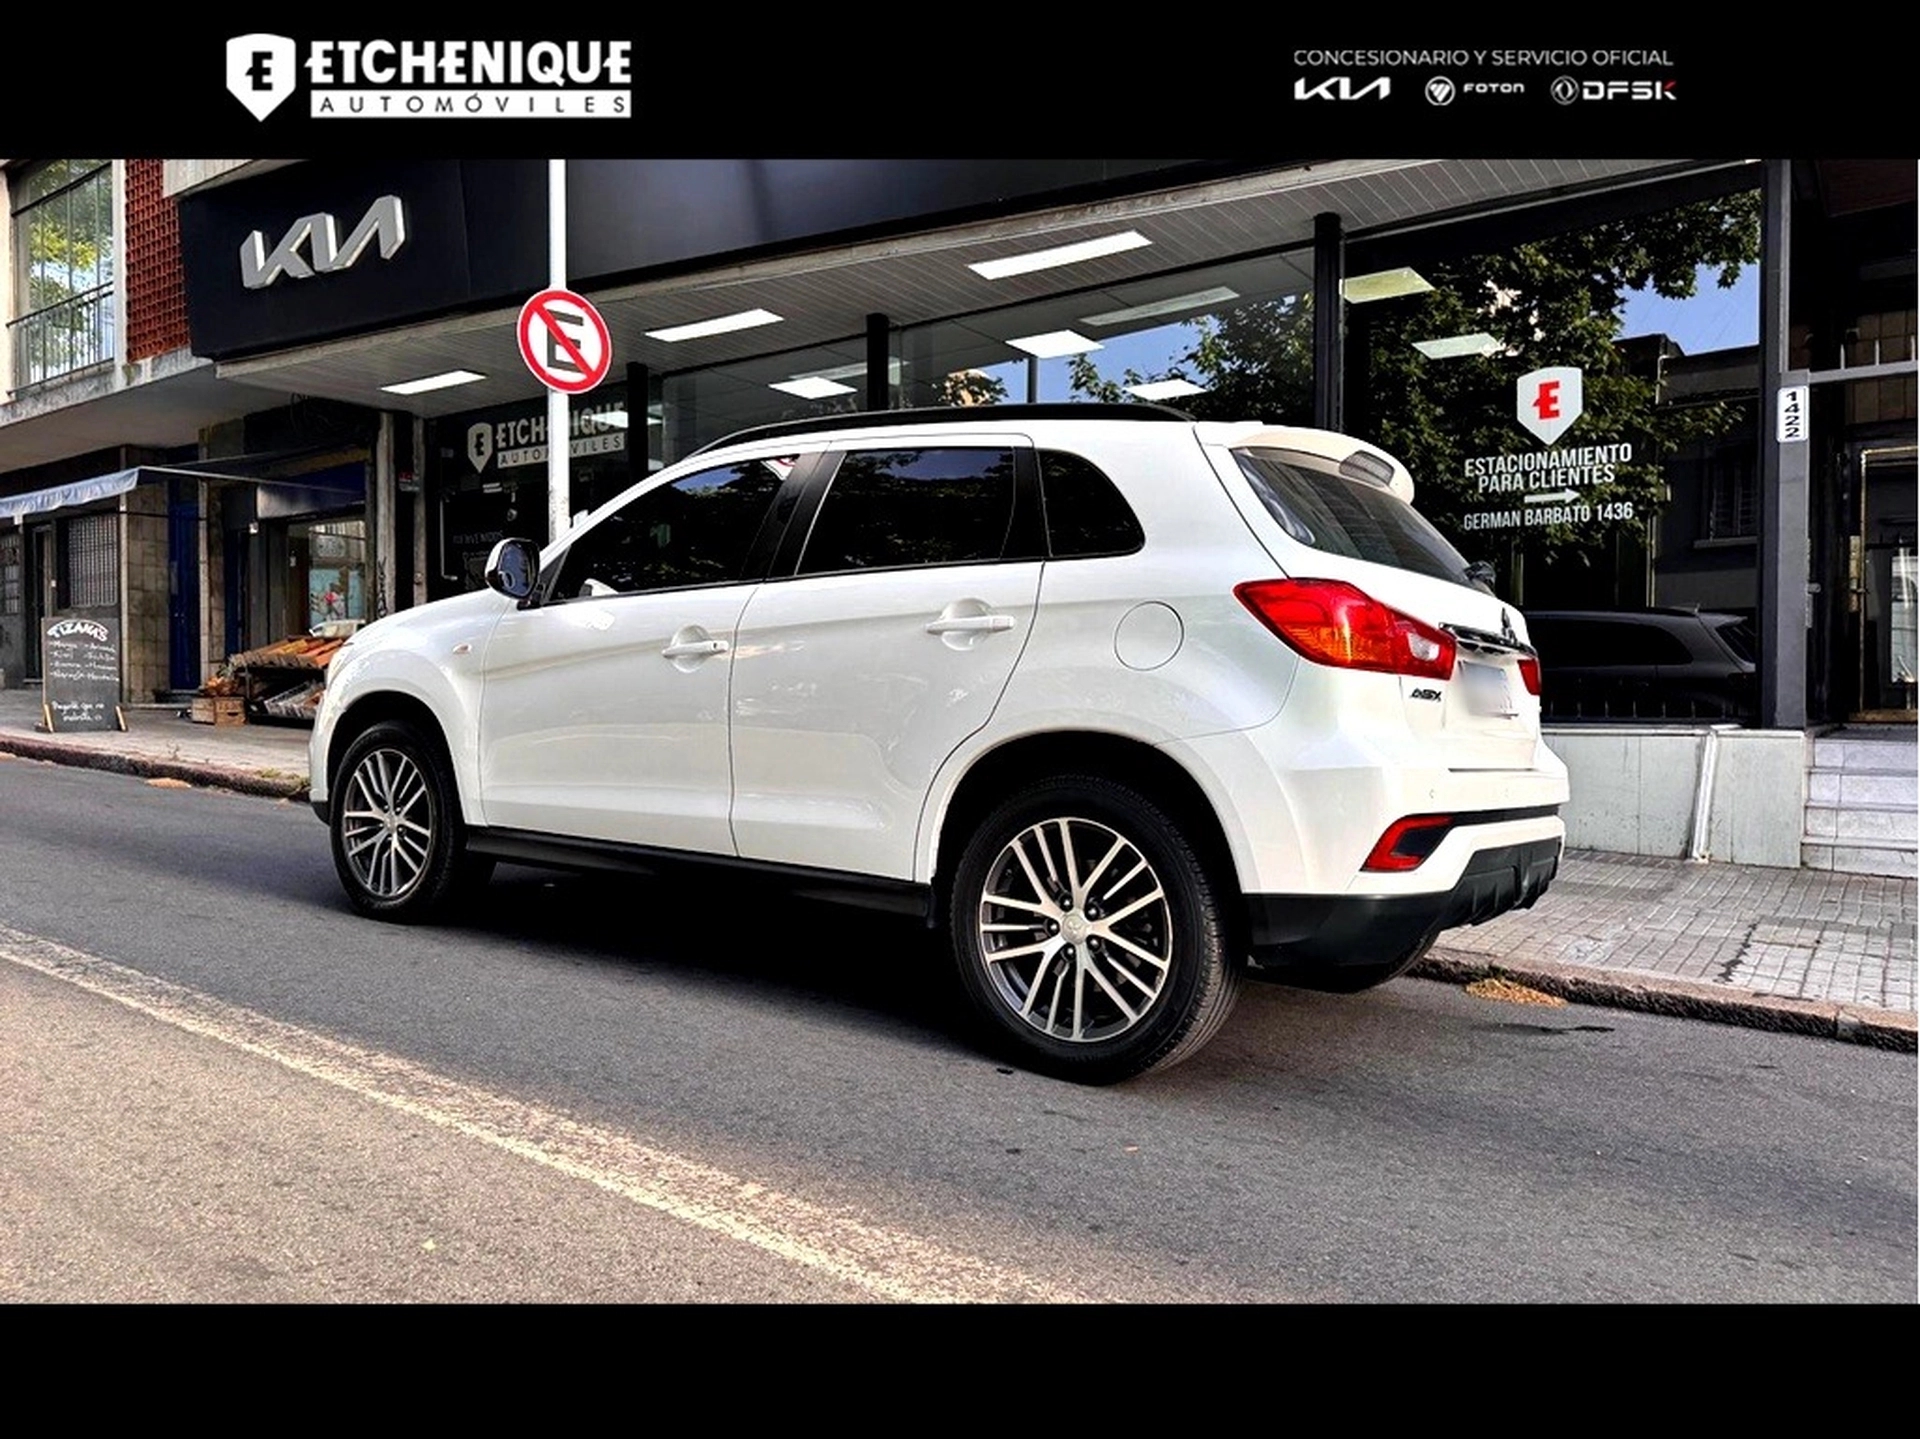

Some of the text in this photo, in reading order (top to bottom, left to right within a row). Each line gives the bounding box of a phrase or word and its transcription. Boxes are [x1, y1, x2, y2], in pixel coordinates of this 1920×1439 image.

[240, 194, 406, 290] KIA
[1784, 391, 1800, 439] 1422
[1464, 442, 1633, 478] ESTACIONAMIENTO
[1478, 463, 1616, 494] PARA CLIENTES
[1463, 501, 1634, 531] GERMAN BARBATO 1436
[1410, 687, 1443, 702] ASX
